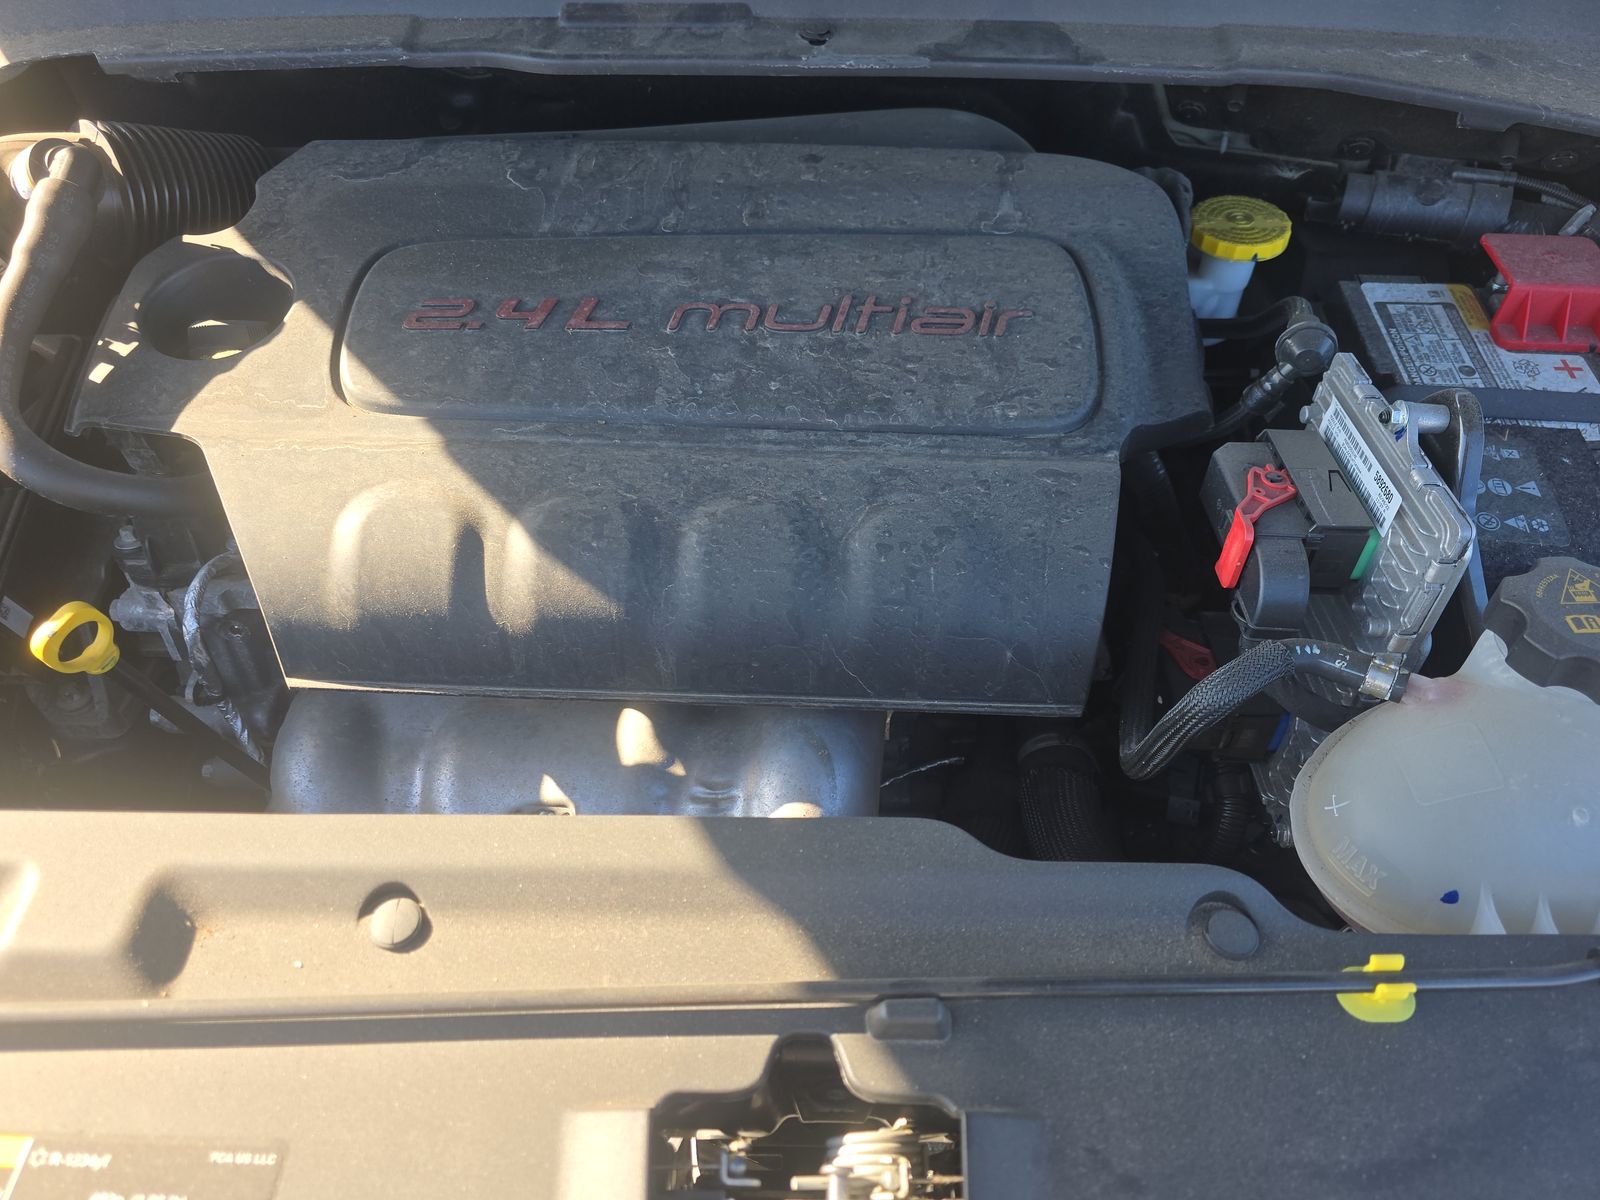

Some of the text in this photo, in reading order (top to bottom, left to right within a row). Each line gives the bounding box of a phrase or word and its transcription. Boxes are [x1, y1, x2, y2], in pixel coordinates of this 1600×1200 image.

[667, 294, 1034, 336] multiair
[1374, 470, 1394, 504] 5892680
[1331, 837, 1388, 890] MAX
